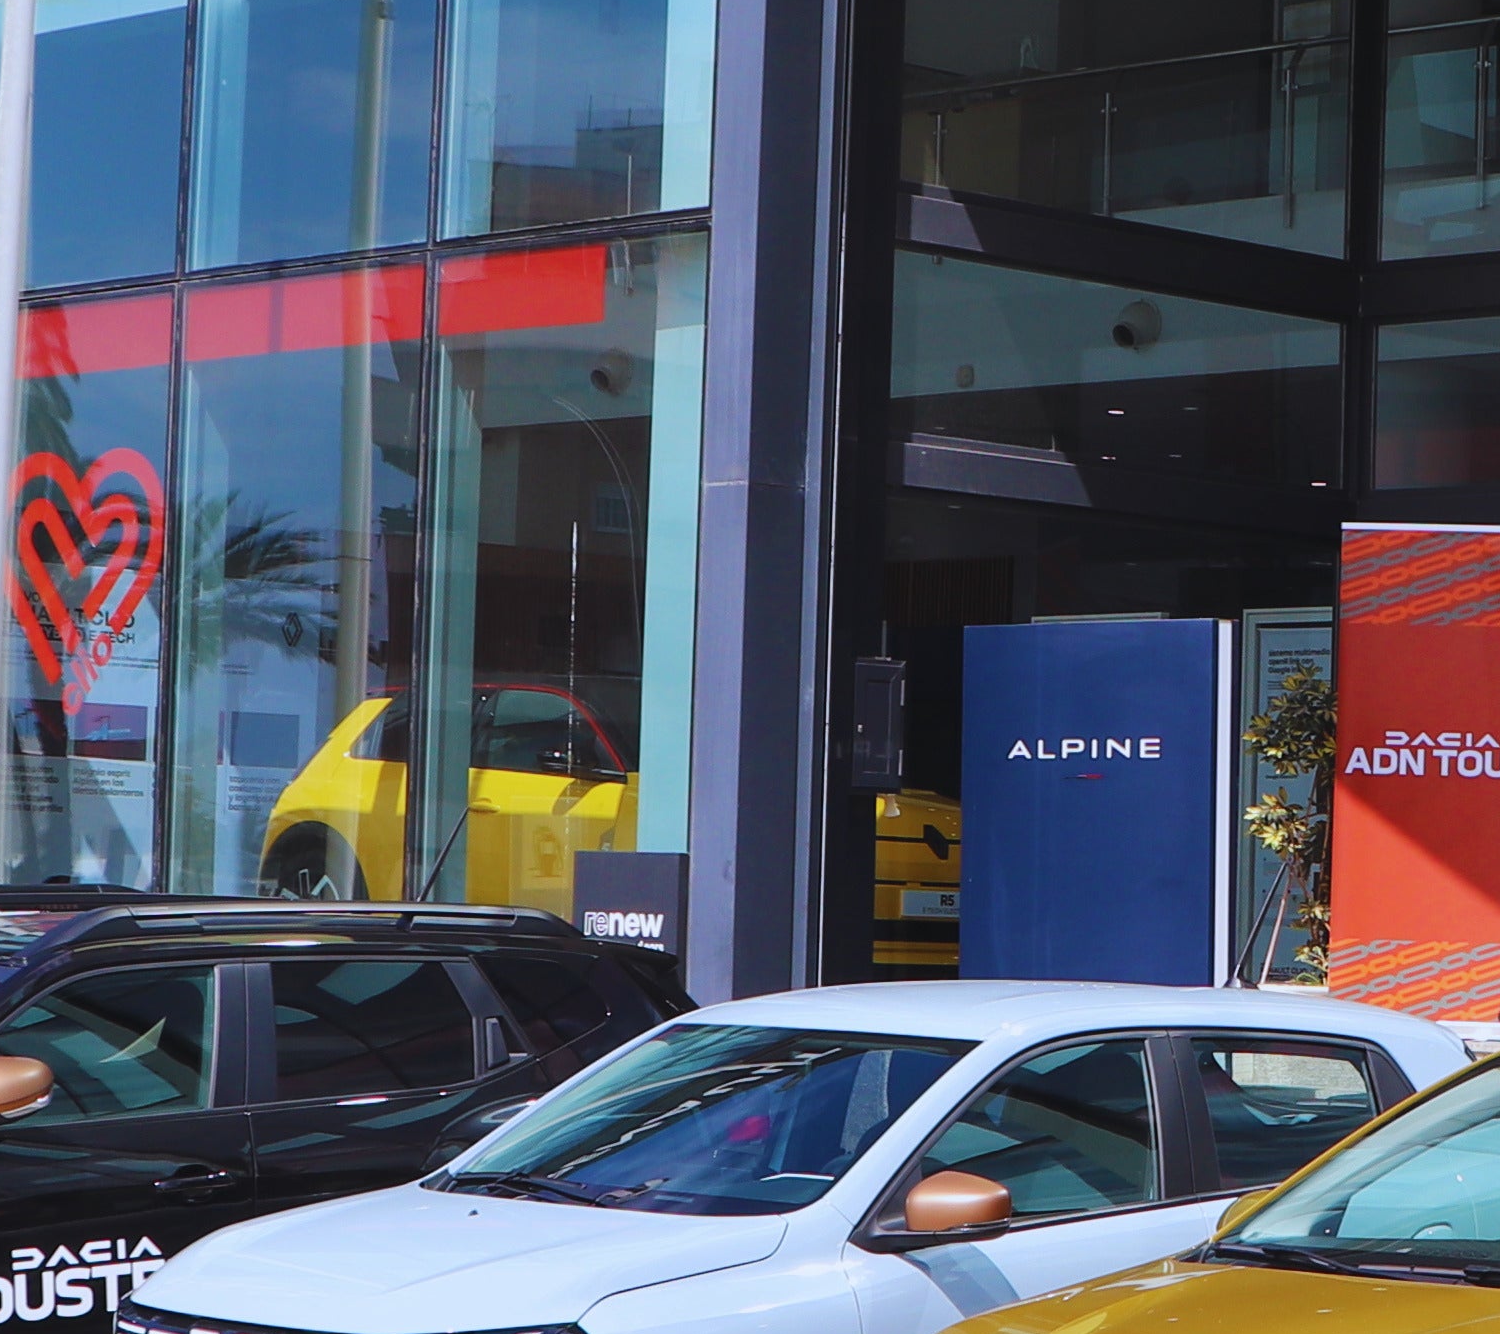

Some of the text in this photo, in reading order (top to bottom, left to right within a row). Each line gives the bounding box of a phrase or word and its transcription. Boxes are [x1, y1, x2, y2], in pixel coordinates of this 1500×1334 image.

[1007, 737, 1161, 759] ALPINE
[1385, 730, 1500, 748] DACIA
[1344, 747, 1425, 776] ADN
[583, 911, 664, 938] renew
[11, 1235, 163, 1271] DACIA
